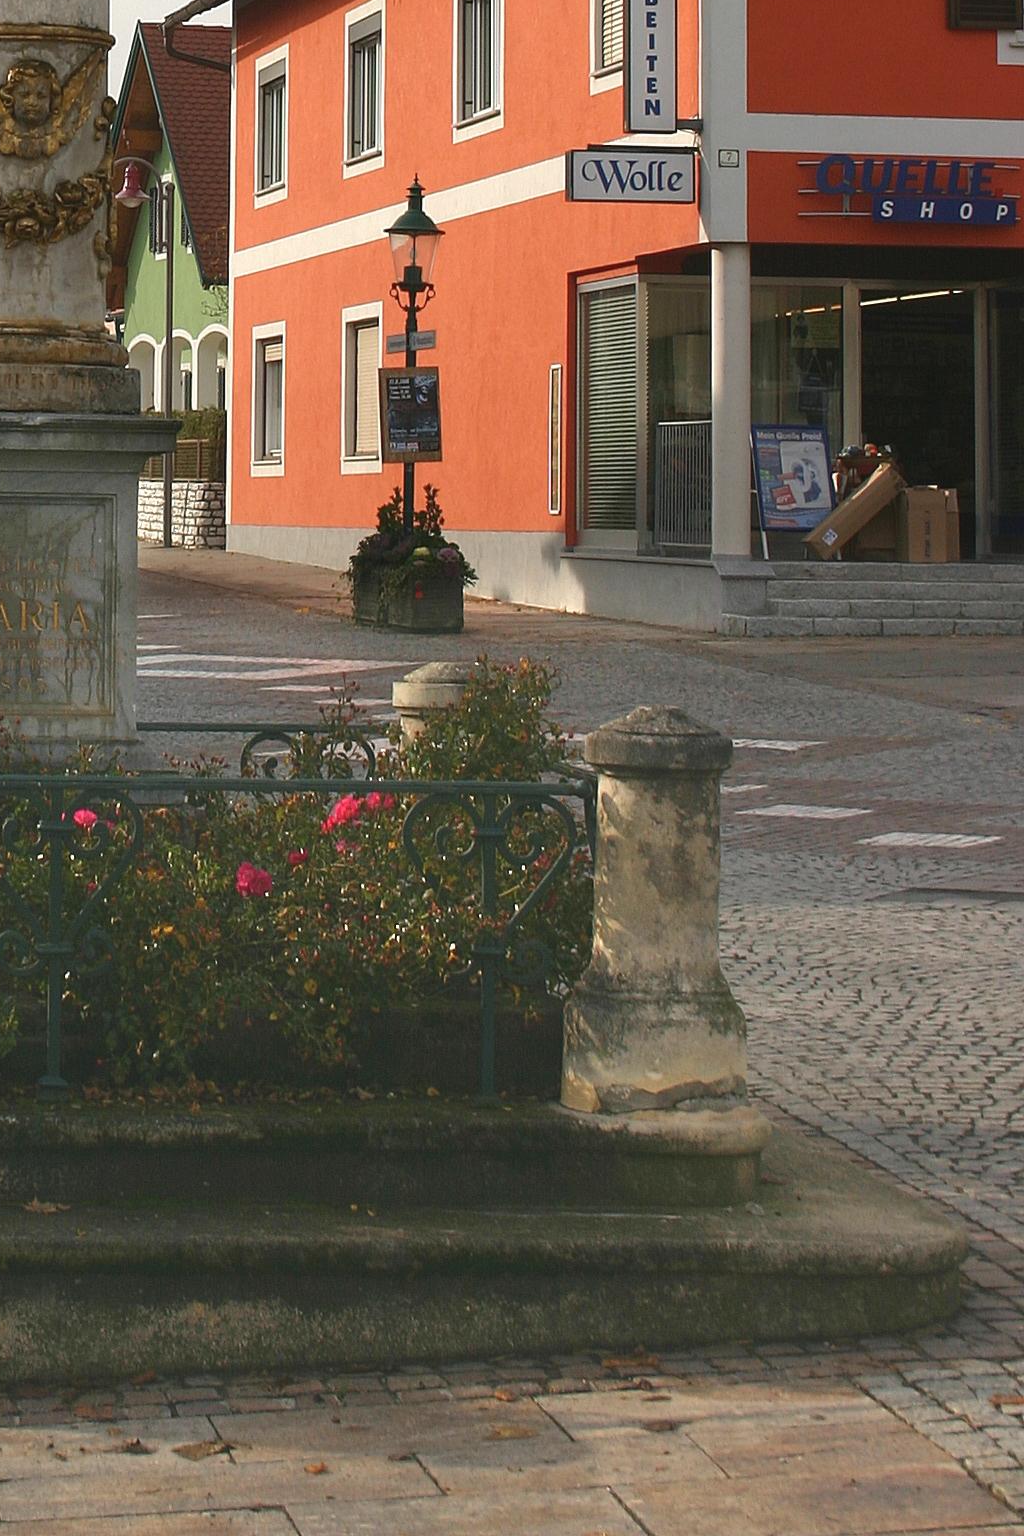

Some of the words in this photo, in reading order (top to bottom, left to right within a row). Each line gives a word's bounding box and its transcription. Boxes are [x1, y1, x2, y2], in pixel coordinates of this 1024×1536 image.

[726, 151, 733, 162] 7
[581, 159, 684, 194] Wolle
[816, 154, 997, 197] QUELLE
[880, 200, 1009, 221] SHOP
